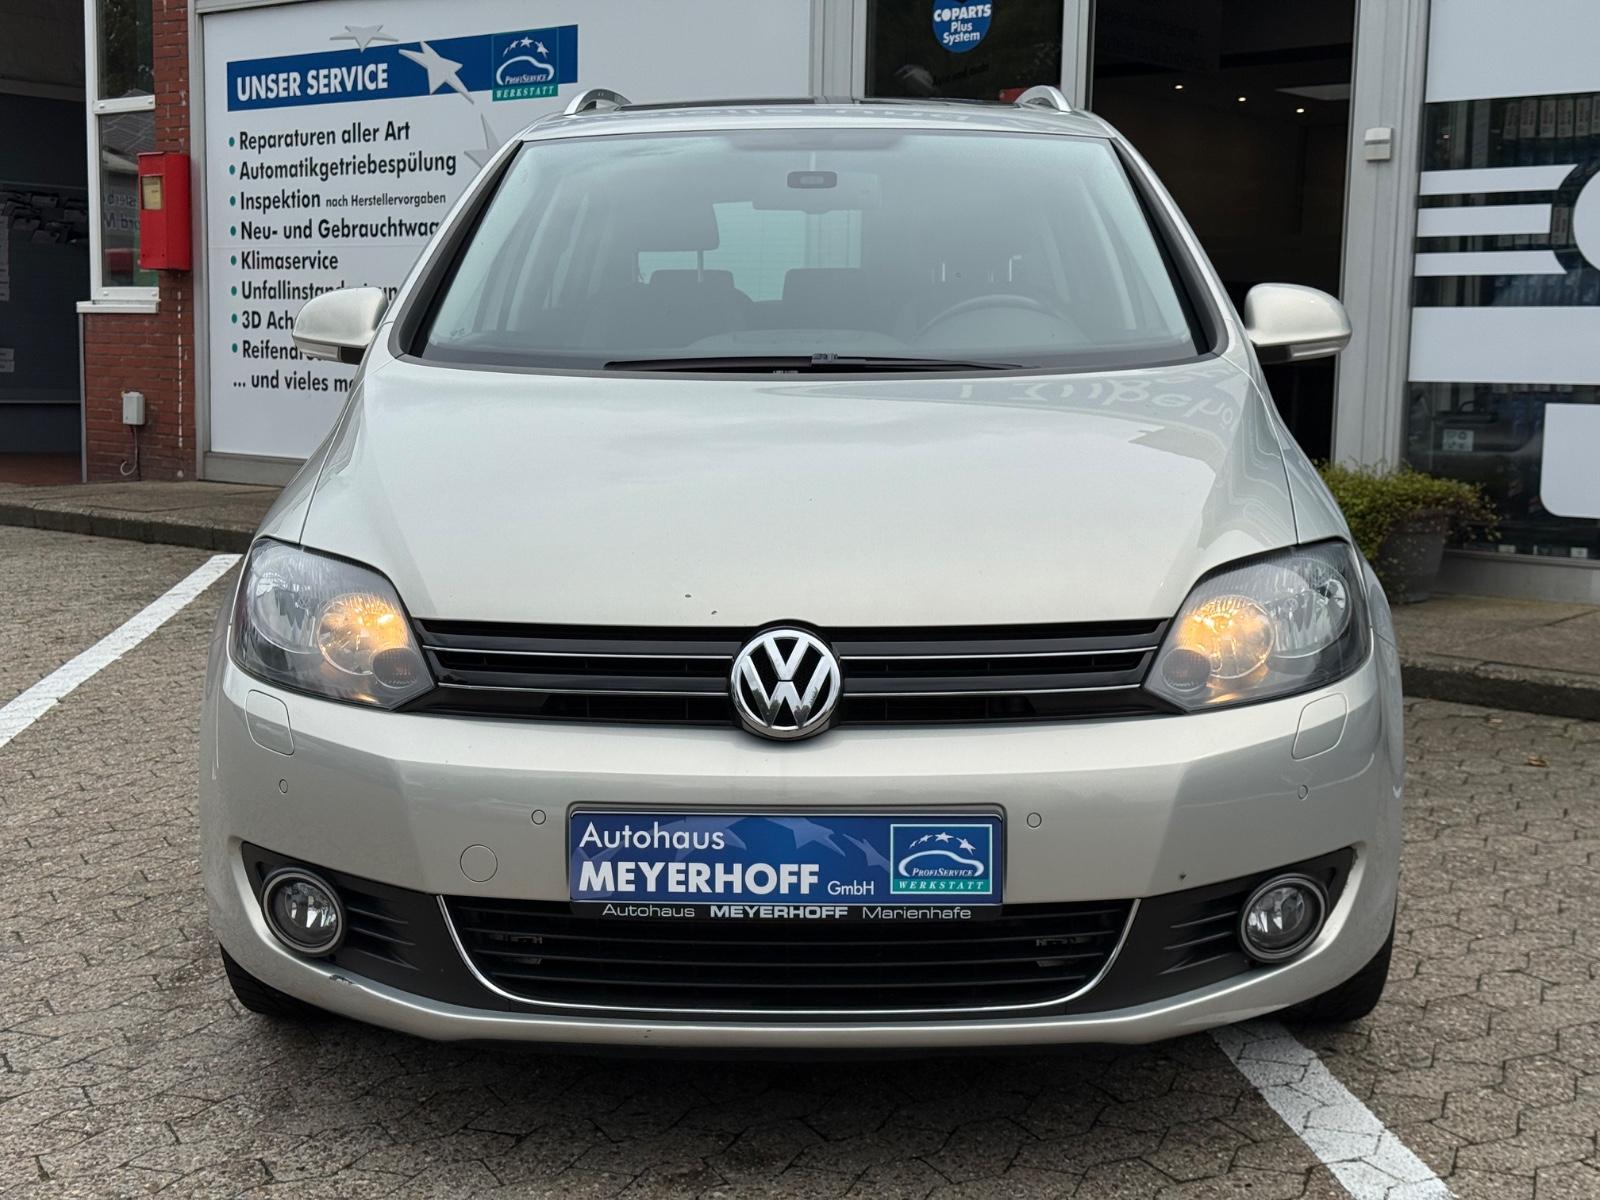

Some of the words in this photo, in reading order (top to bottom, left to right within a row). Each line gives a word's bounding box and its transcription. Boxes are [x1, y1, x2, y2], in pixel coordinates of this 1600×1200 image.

[934, 4, 992, 22] COPARTS
[951, 21, 973, 32] Plus
[943, 32, 980, 46] System
[237, 72, 302, 102] UNSER
[306, 63, 389, 96] SERVICE
[496, 86, 555, 98] WERKSTATT
[239, 129, 336, 154] Reparaturen
[341, 121, 380, 144] aller
[384, 120, 411, 142] Art
[239, 150, 457, 182] Automatikgetriebespülung
[240, 189, 321, 214] Inspektion
[325, 195, 349, 208] nach
[351, 191, 447, 208] Herstellervorgaben
[241, 221, 278, 240] Neu-
[283, 219, 313, 239] und
[241, 250, 339, 270] Klimaservice
[242, 310, 262, 330] 3D
[267, 309, 296, 330] Ach
[251, 369, 280, 389] und
[284, 370, 329, 392] vieles
[579, 821, 726, 850] Autohaus
[578, 861, 820, 895] MEYERHOFF
[827, 880, 875, 896] GmbH
[899, 881, 985, 891] WERKSTATT
[602, 903, 696, 918] Autohaus
[710, 905, 849, 919] MEYERHOFF
[862, 906, 972, 920] Marienhafe
